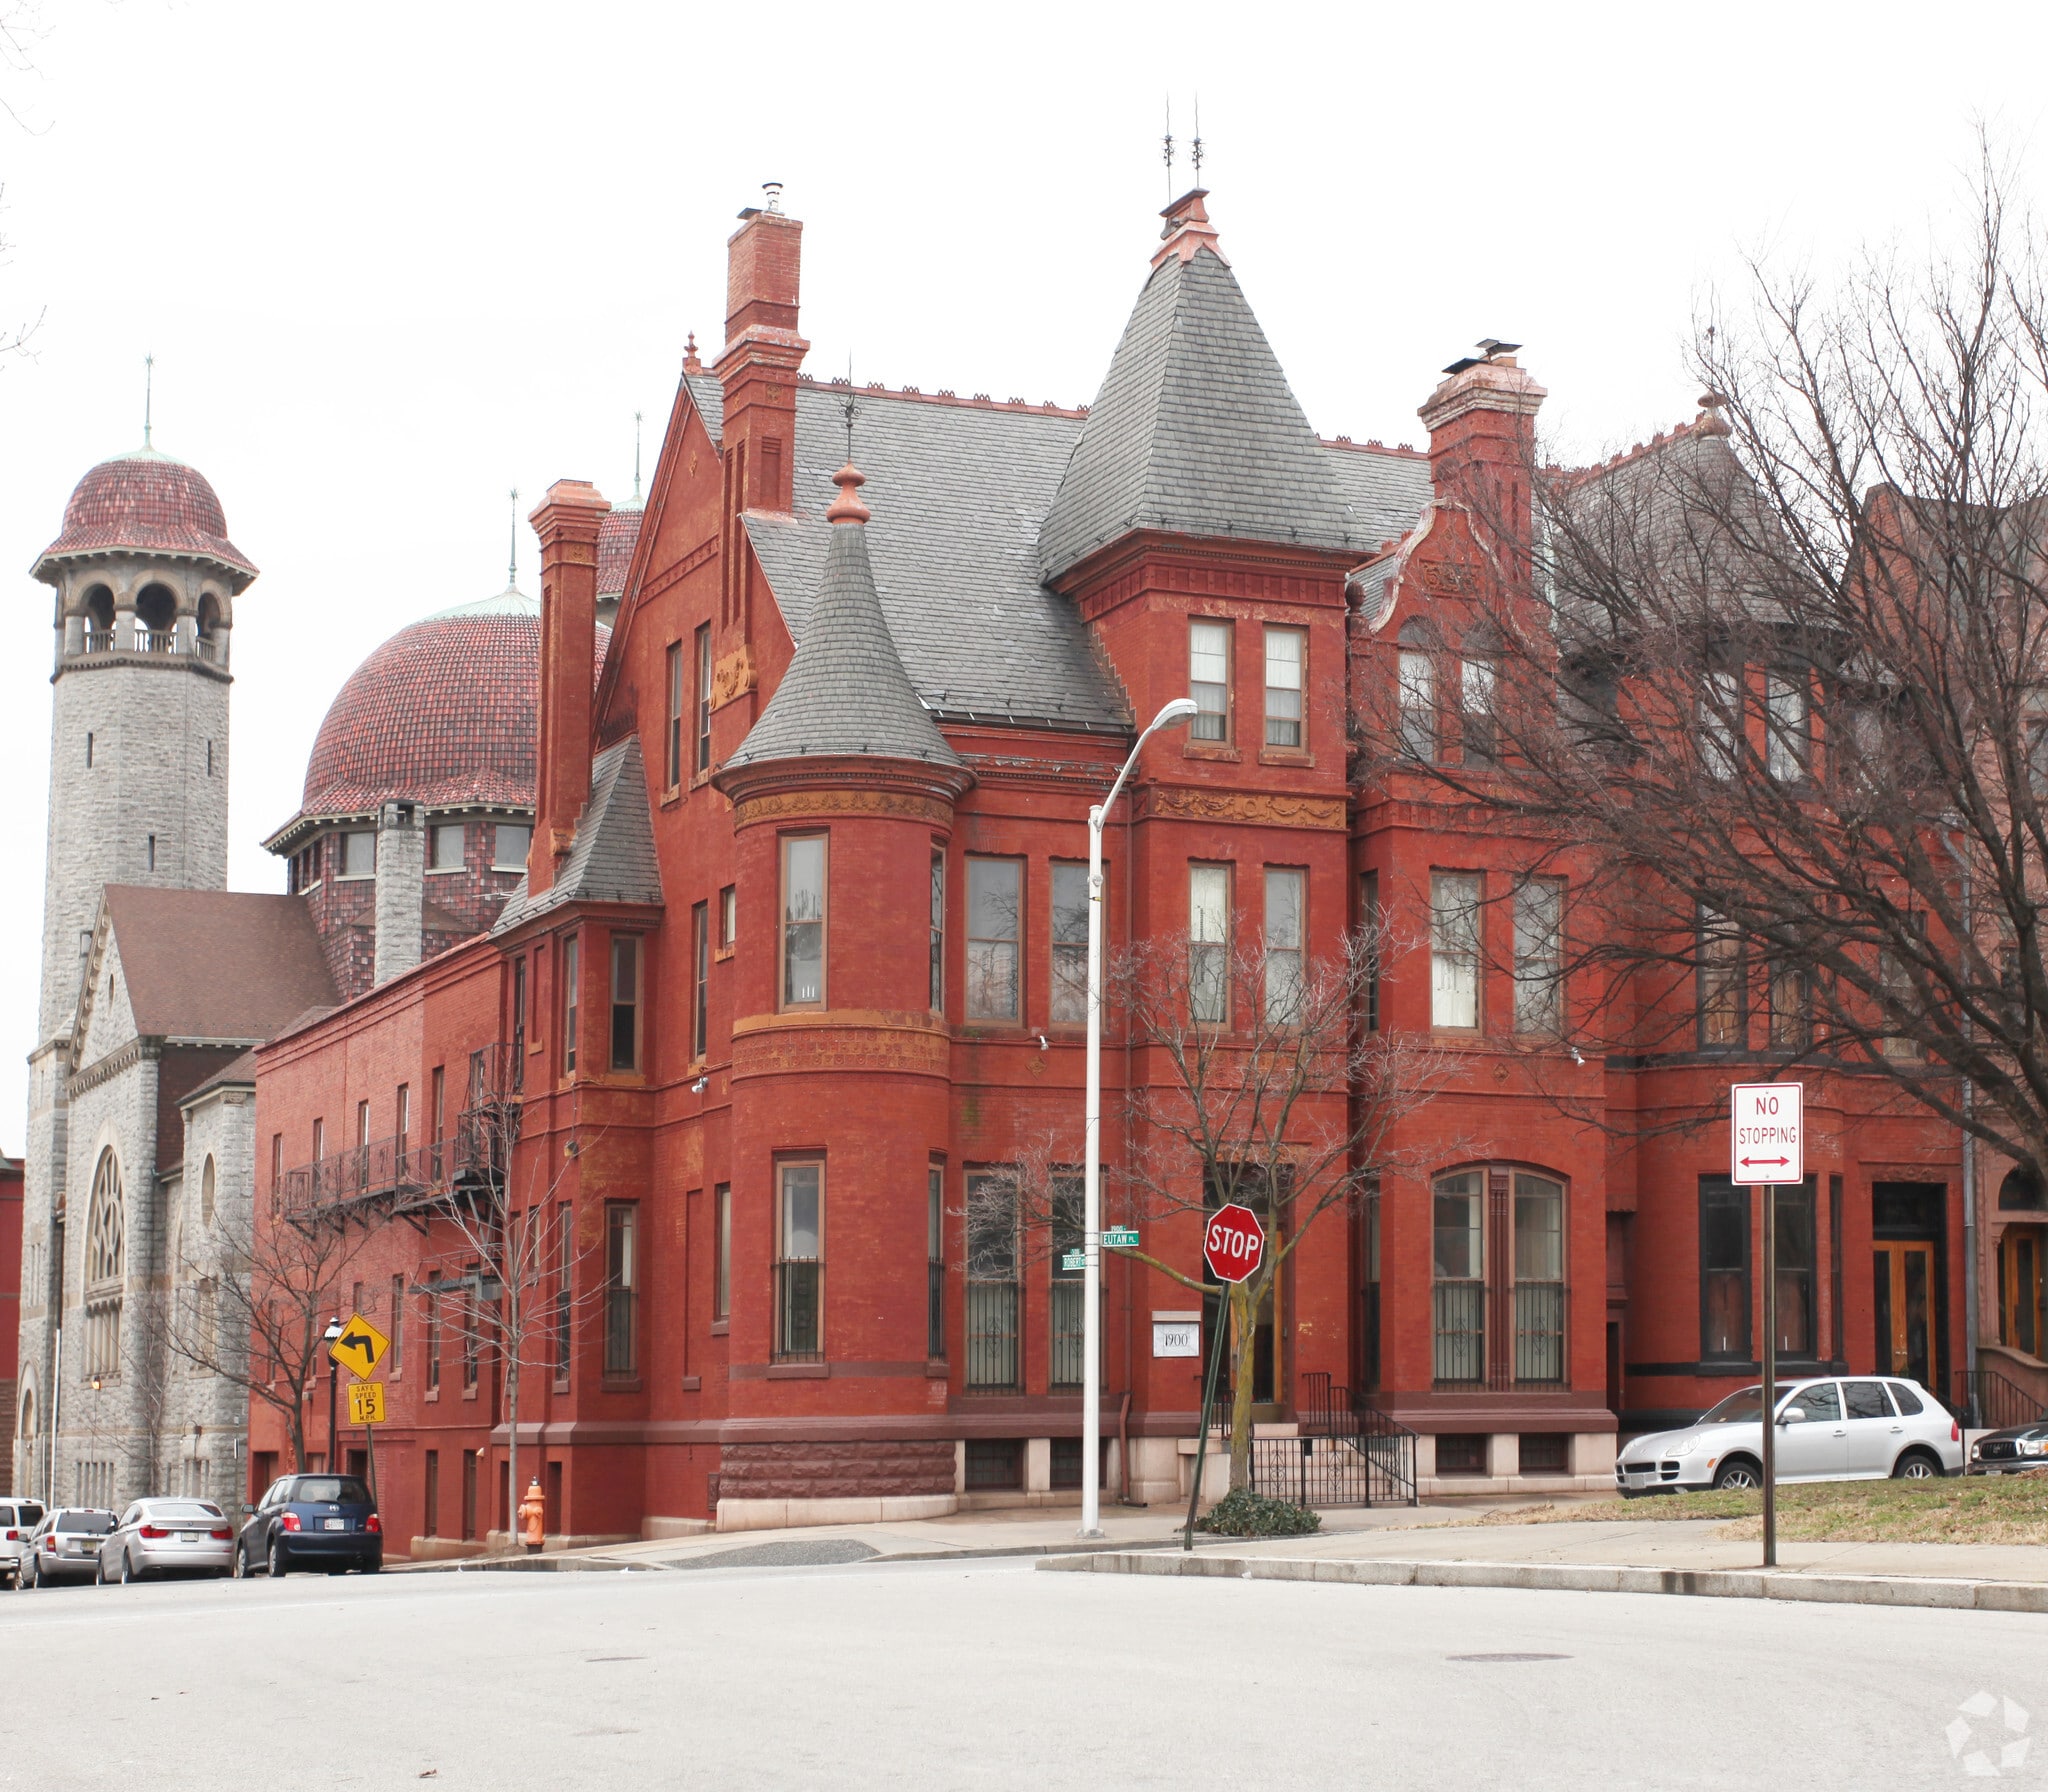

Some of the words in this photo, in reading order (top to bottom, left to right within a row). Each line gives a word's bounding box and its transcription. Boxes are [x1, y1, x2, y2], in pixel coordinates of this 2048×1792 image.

[1756, 1097, 1779, 1115] NO
[1739, 1126, 1797, 1145] STOPPING
[1103, 1234, 1128, 1245] EUTAW
[1209, 1224, 1259, 1261] STOP
[1164, 1333, 1189, 1347] 1900
[358, 1399, 375, 1415] 15
